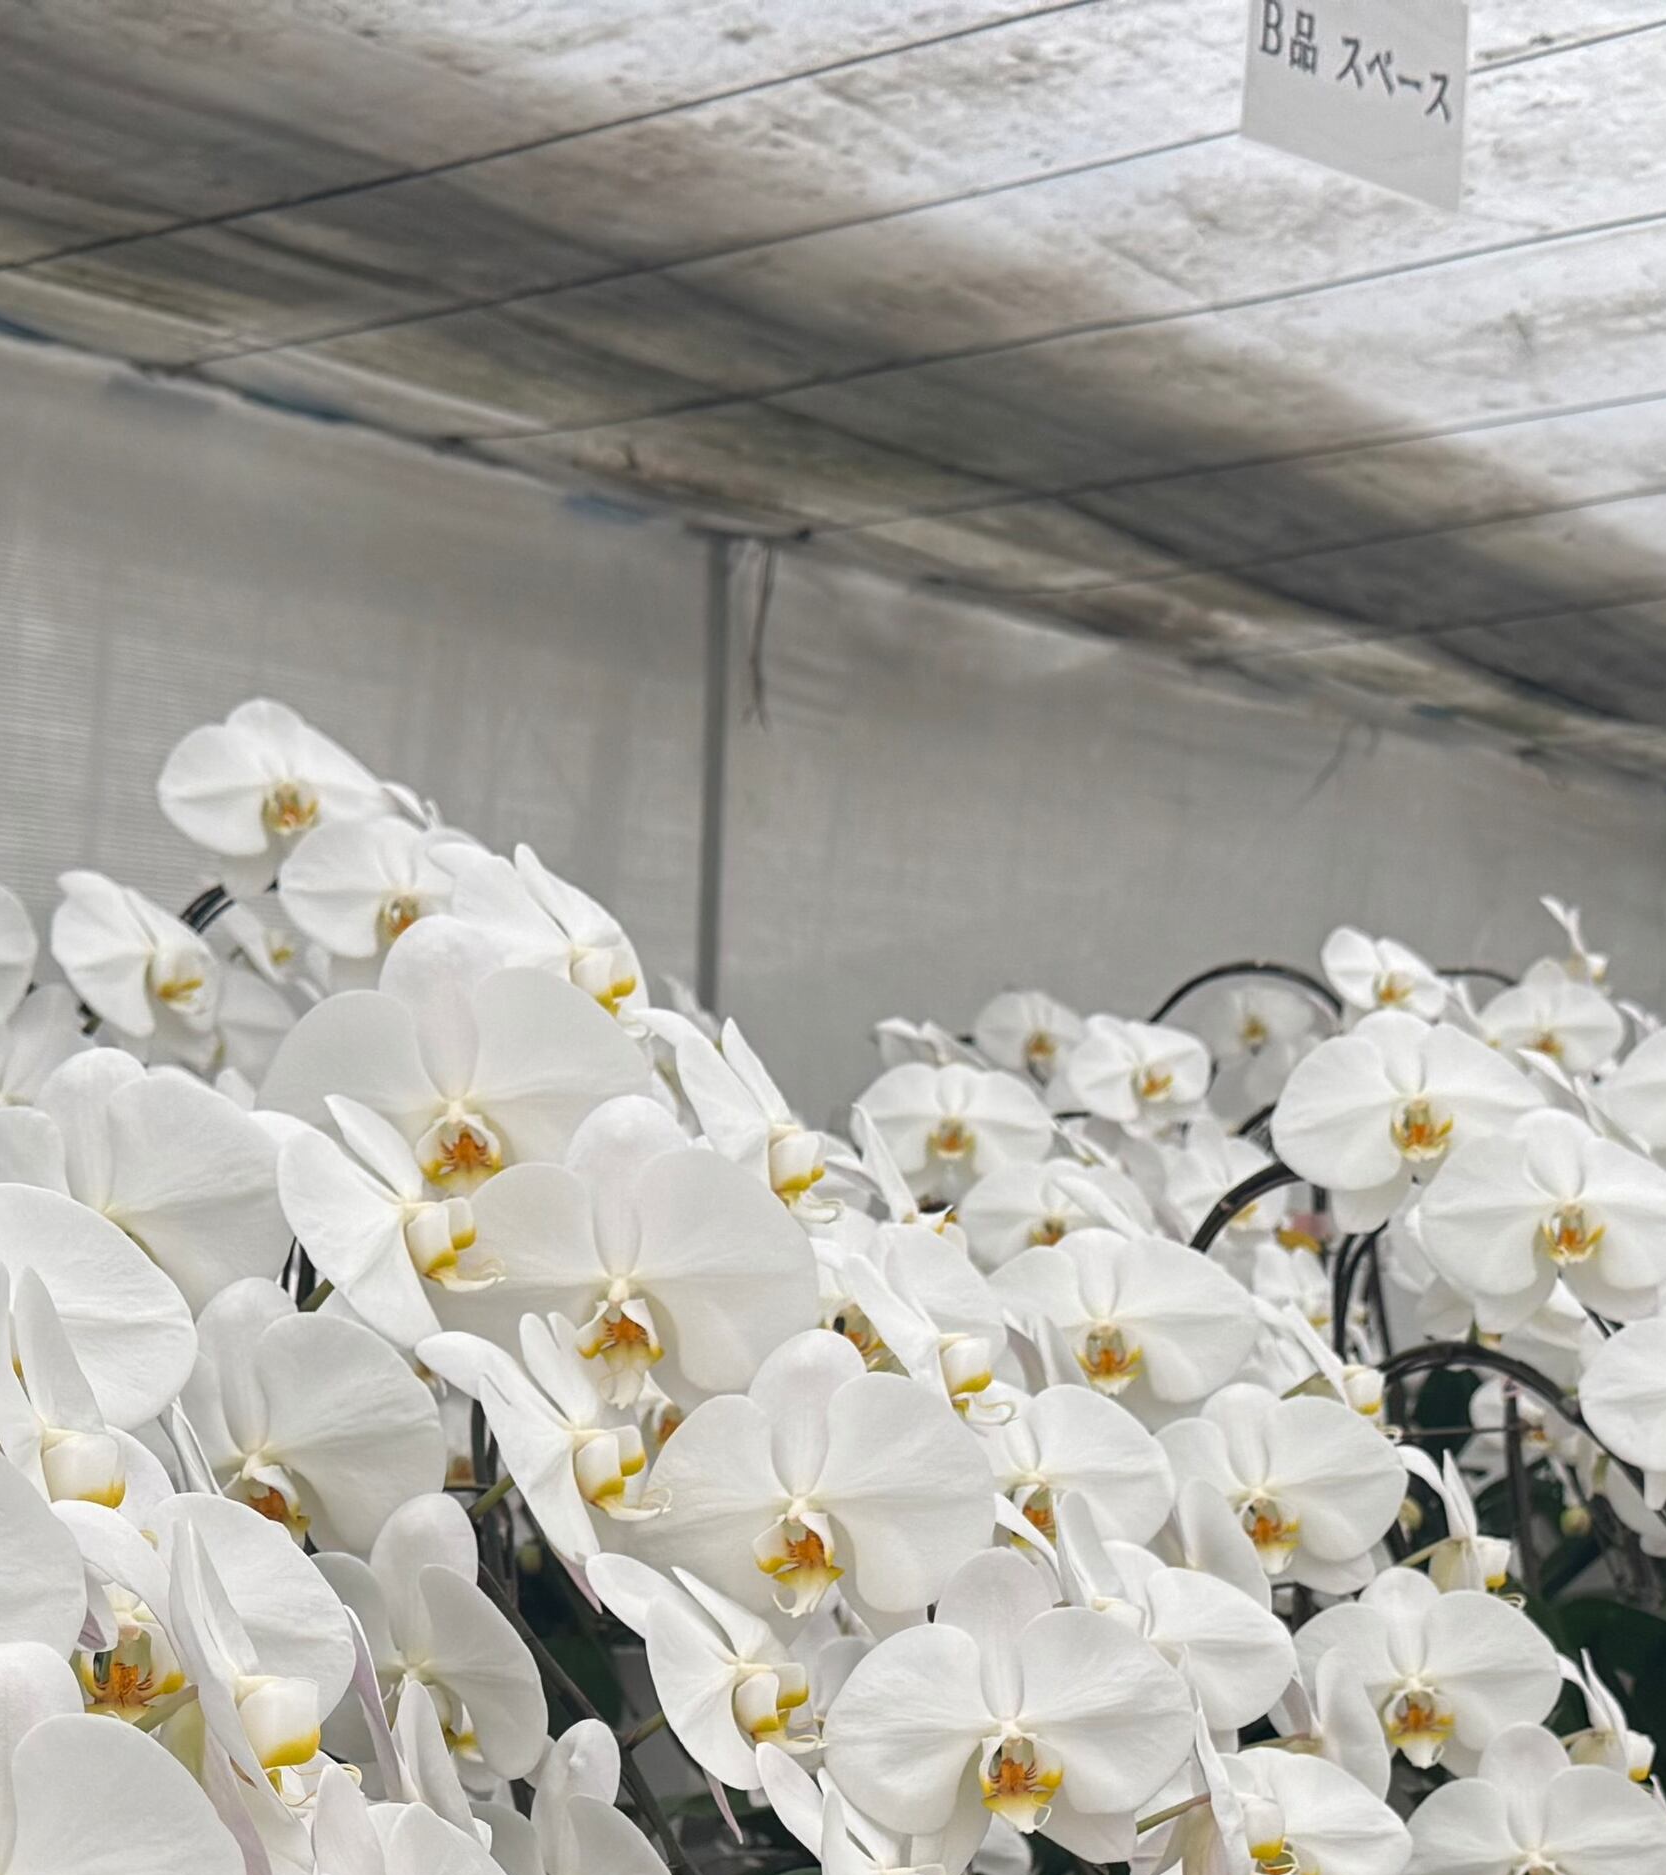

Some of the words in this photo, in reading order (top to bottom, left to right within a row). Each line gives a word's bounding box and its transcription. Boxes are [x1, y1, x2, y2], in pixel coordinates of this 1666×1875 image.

[1260, 0, 1319, 74] B品
[1337, 36, 1450, 123] スペース
